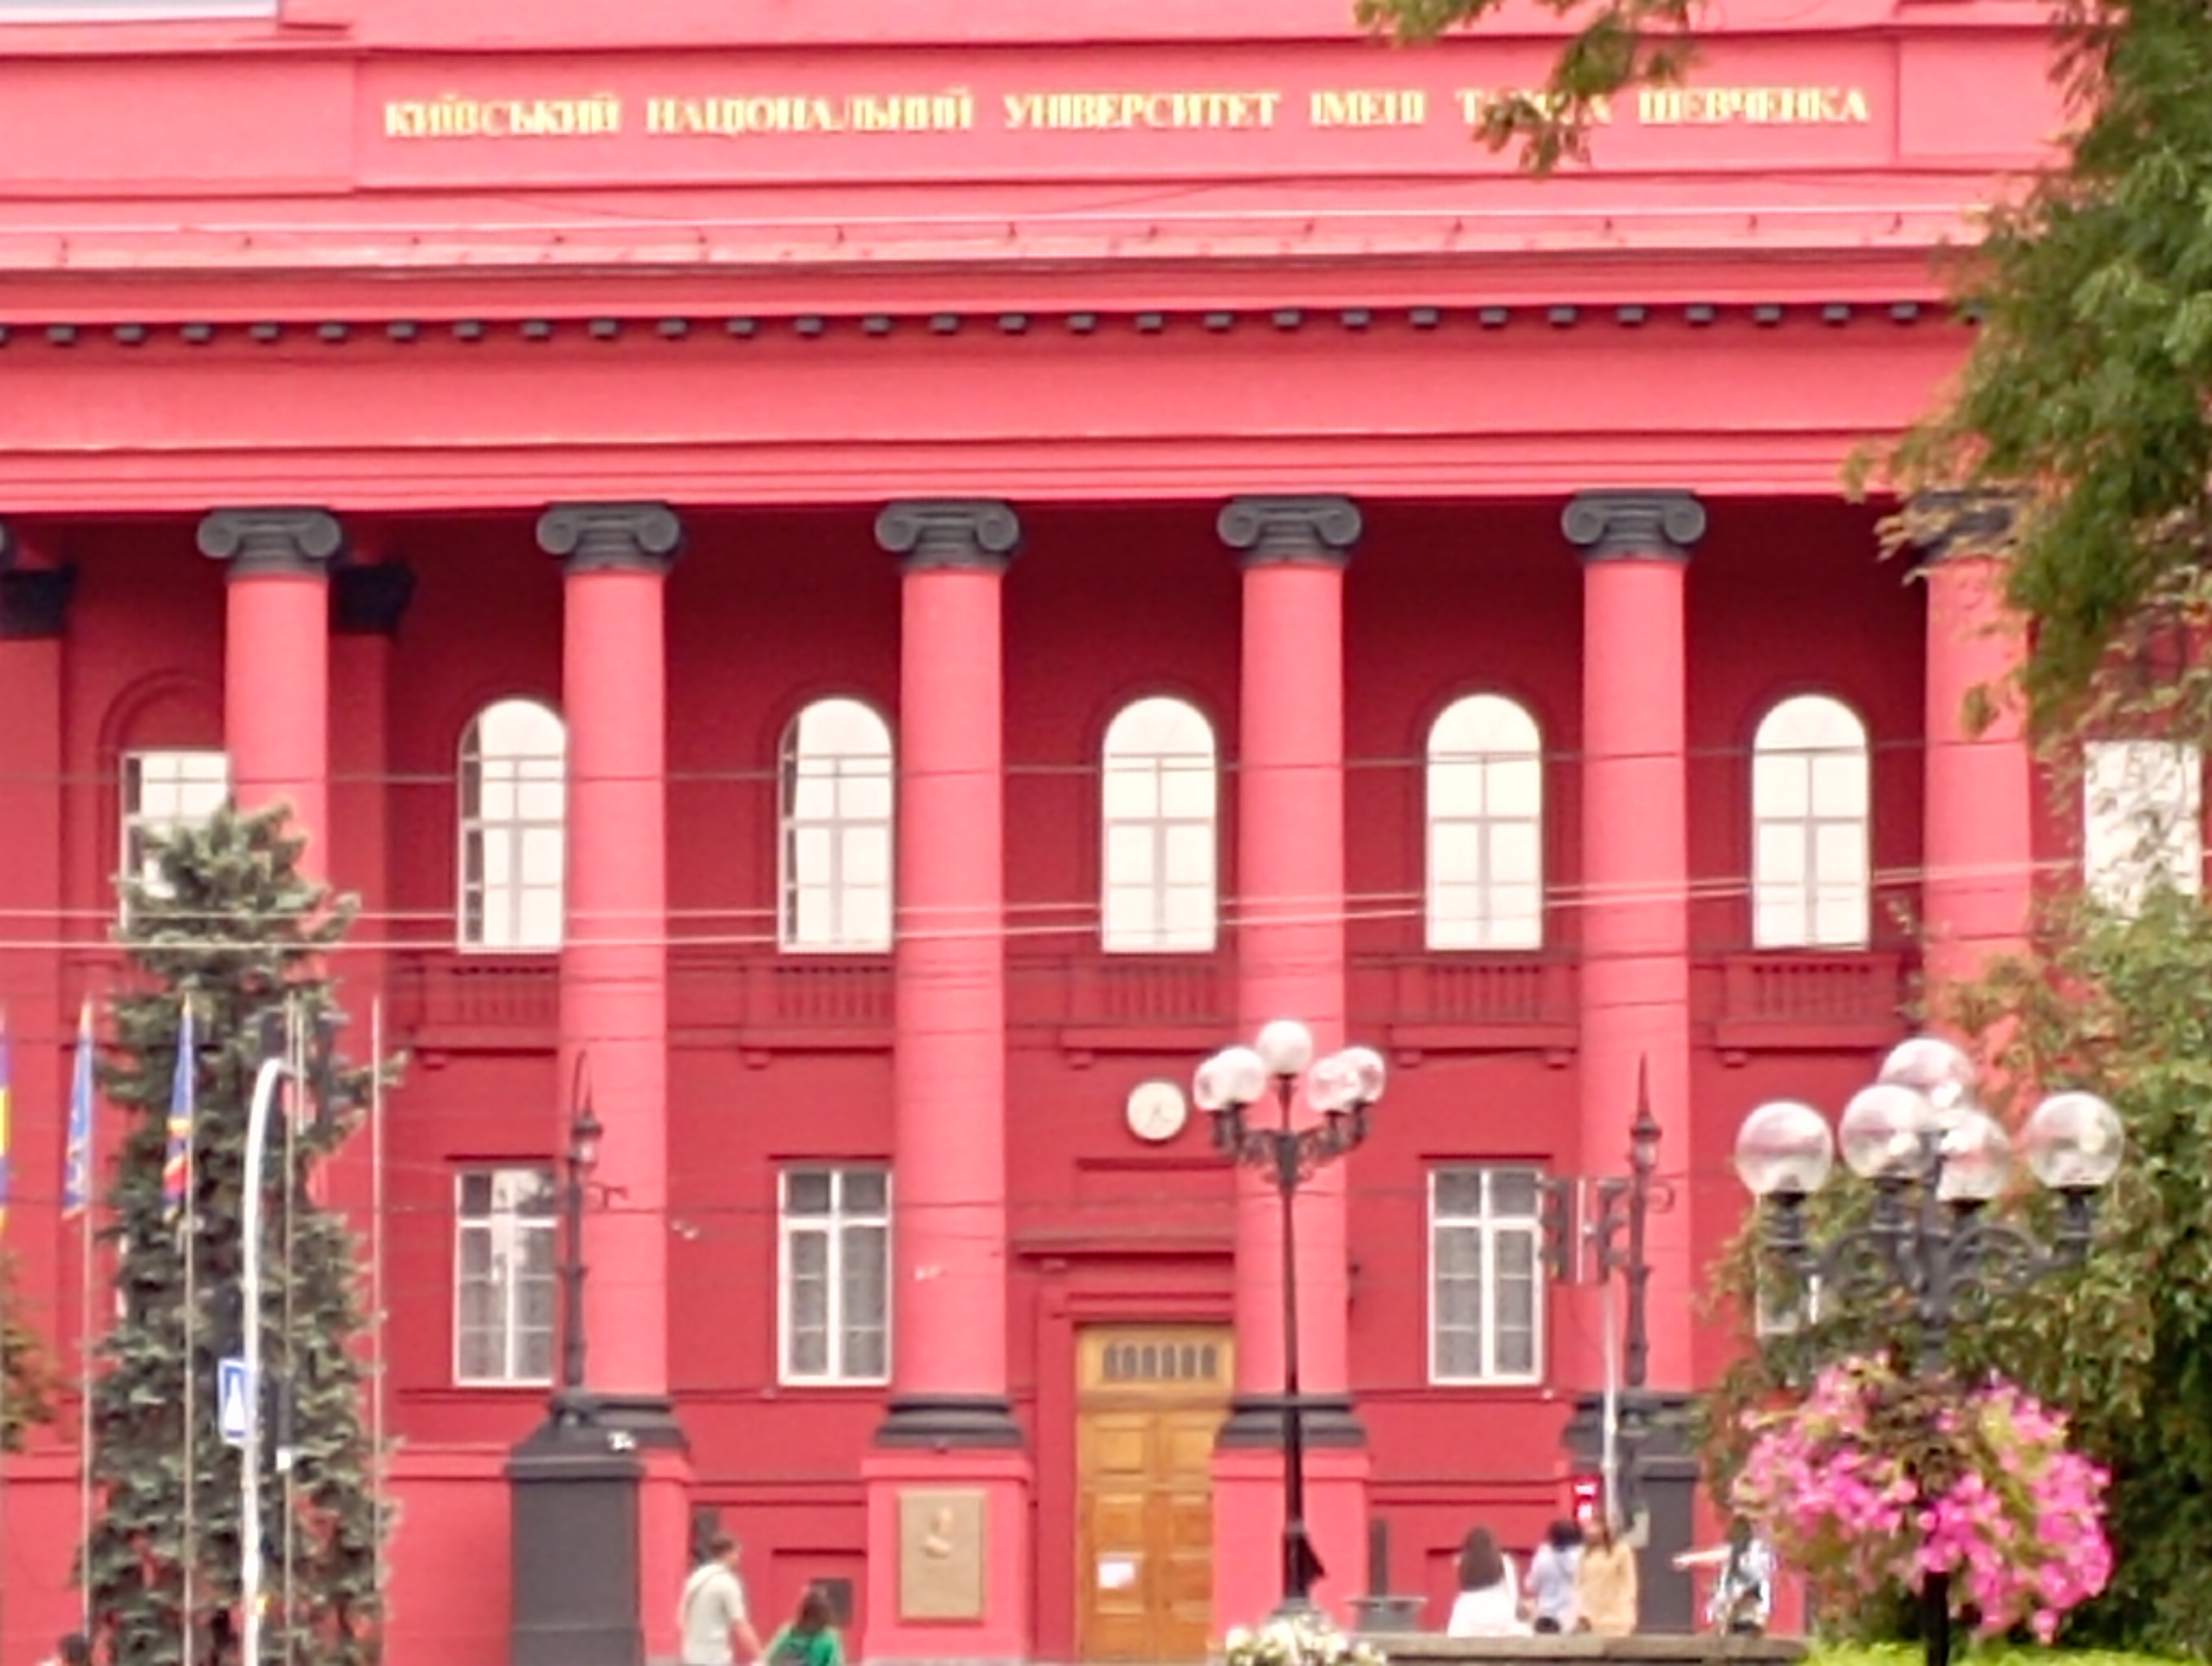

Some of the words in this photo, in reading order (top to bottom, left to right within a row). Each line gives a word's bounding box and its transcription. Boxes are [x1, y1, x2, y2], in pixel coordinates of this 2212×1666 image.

[385, 93, 620, 136] КИЇВСЬКИЙ
[646, 86, 974, 137] НАЦІОНАЛЬНИЙ
[1002, 92, 1281, 129] УНІВЕРСИТЕТ
[1310, 91, 1424, 125] ІМЕНІ
[1638, 88, 1870, 124] ШЕВЧЕНКА
